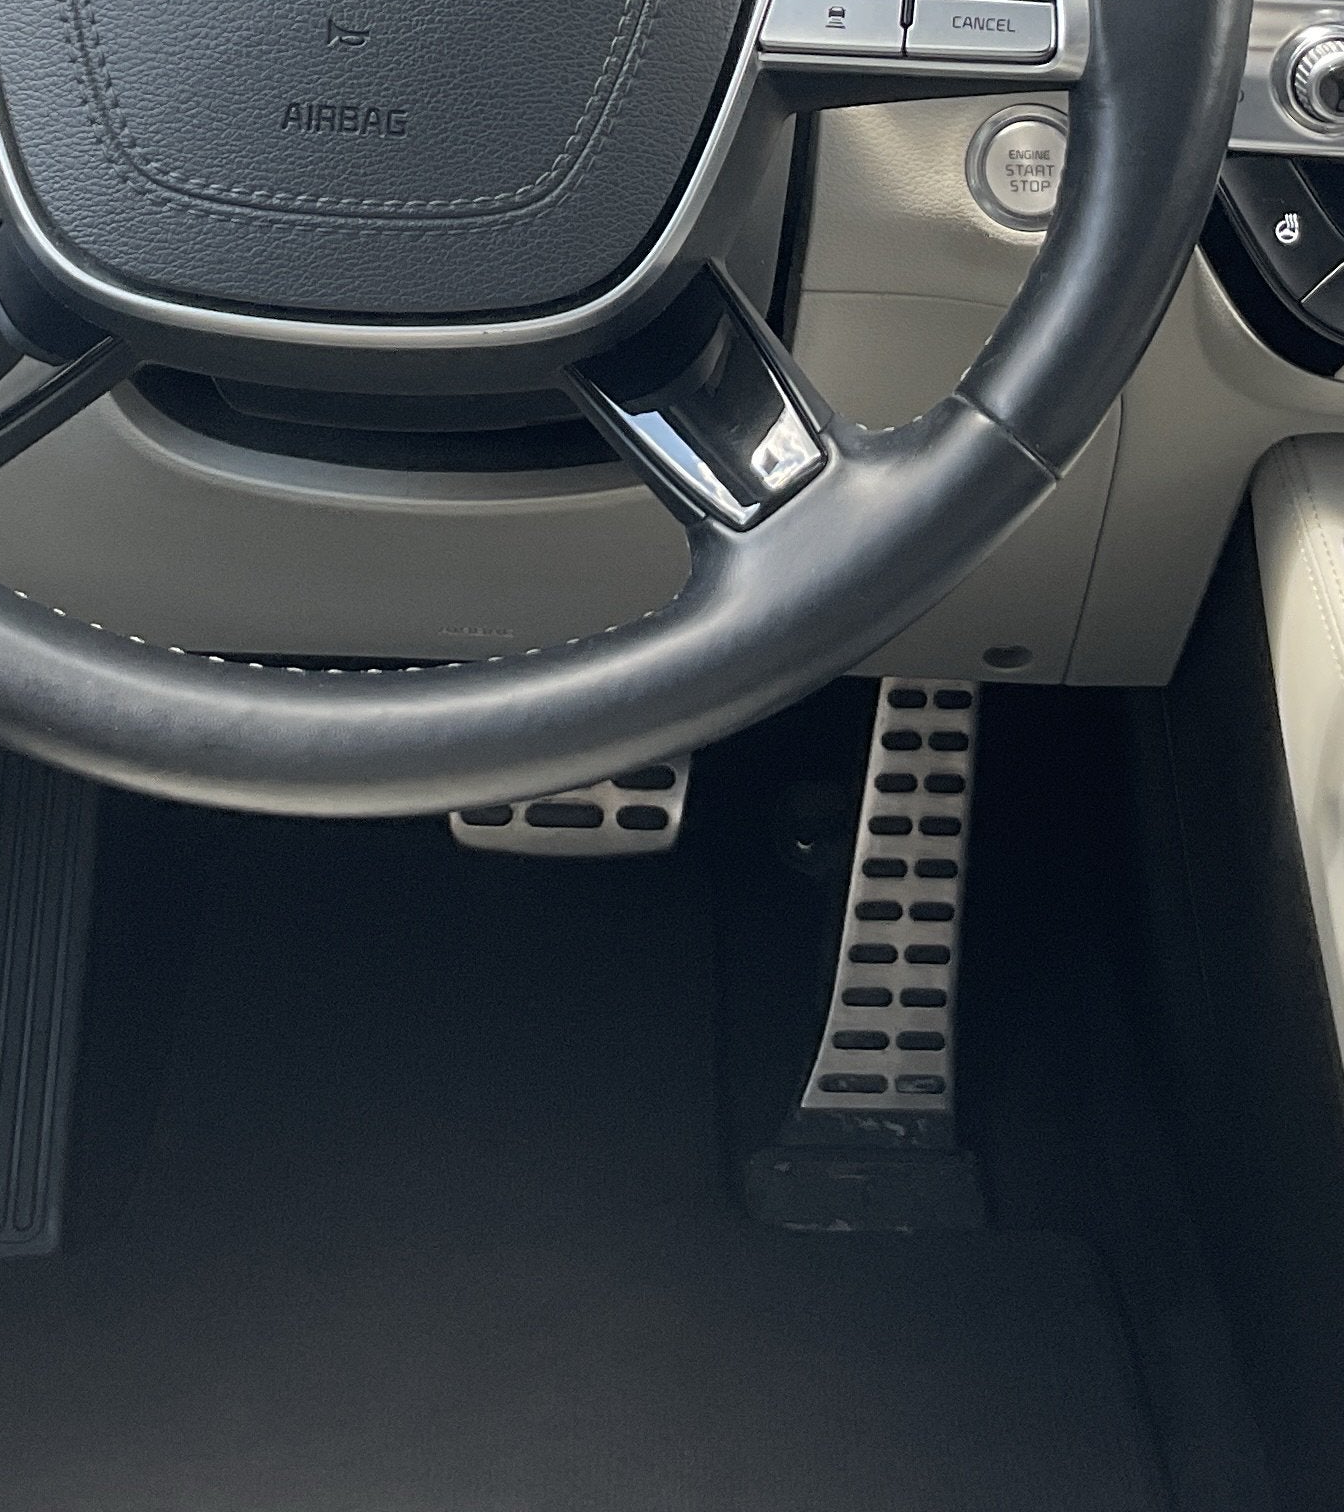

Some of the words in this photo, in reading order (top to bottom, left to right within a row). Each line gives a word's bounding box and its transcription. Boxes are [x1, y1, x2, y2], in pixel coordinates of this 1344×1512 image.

[952, 15, 1016, 33] CANCEL
[281, 102, 408, 137] AIRBAG
[1008, 149, 1051, 161] ENGINE
[1005, 164, 1055, 177] START
[1010, 179, 1051, 193] STOP
